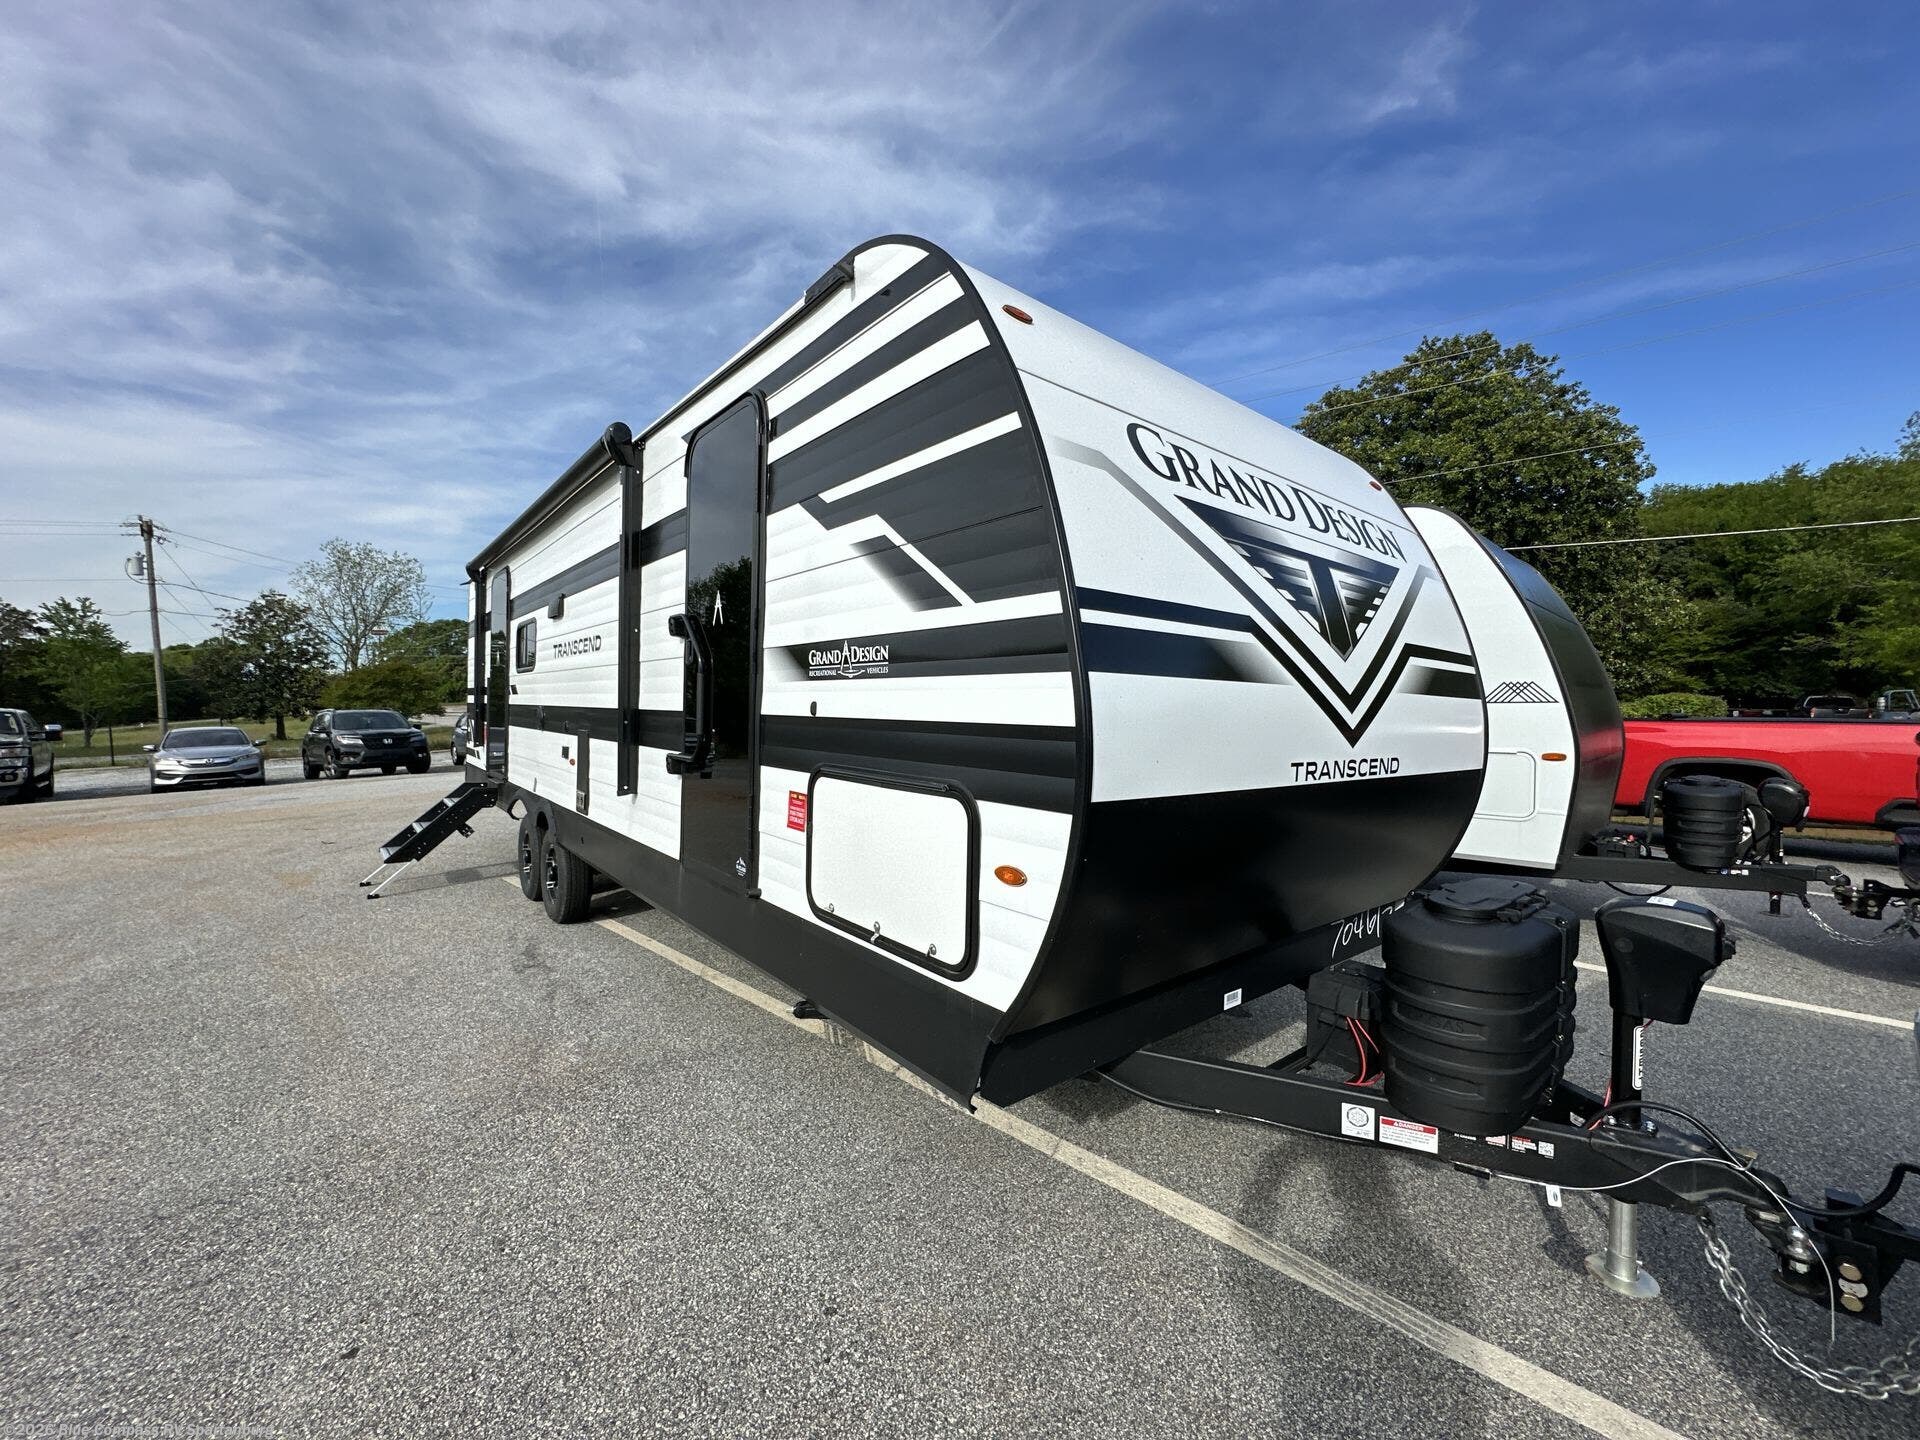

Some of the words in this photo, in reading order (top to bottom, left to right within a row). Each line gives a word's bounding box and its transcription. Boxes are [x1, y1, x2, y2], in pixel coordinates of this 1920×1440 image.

[1126, 423, 1296, 522] GRAND
[1286, 484, 1407, 563] DESIGN
[553, 635, 602, 659] TRANSCEND
[808, 650, 841, 665] GRAND
[851, 645, 889, 662] DESIGN
[1290, 757, 1400, 782] TRANSCEND
[1398, 1121, 1424, 1132] DANGER
